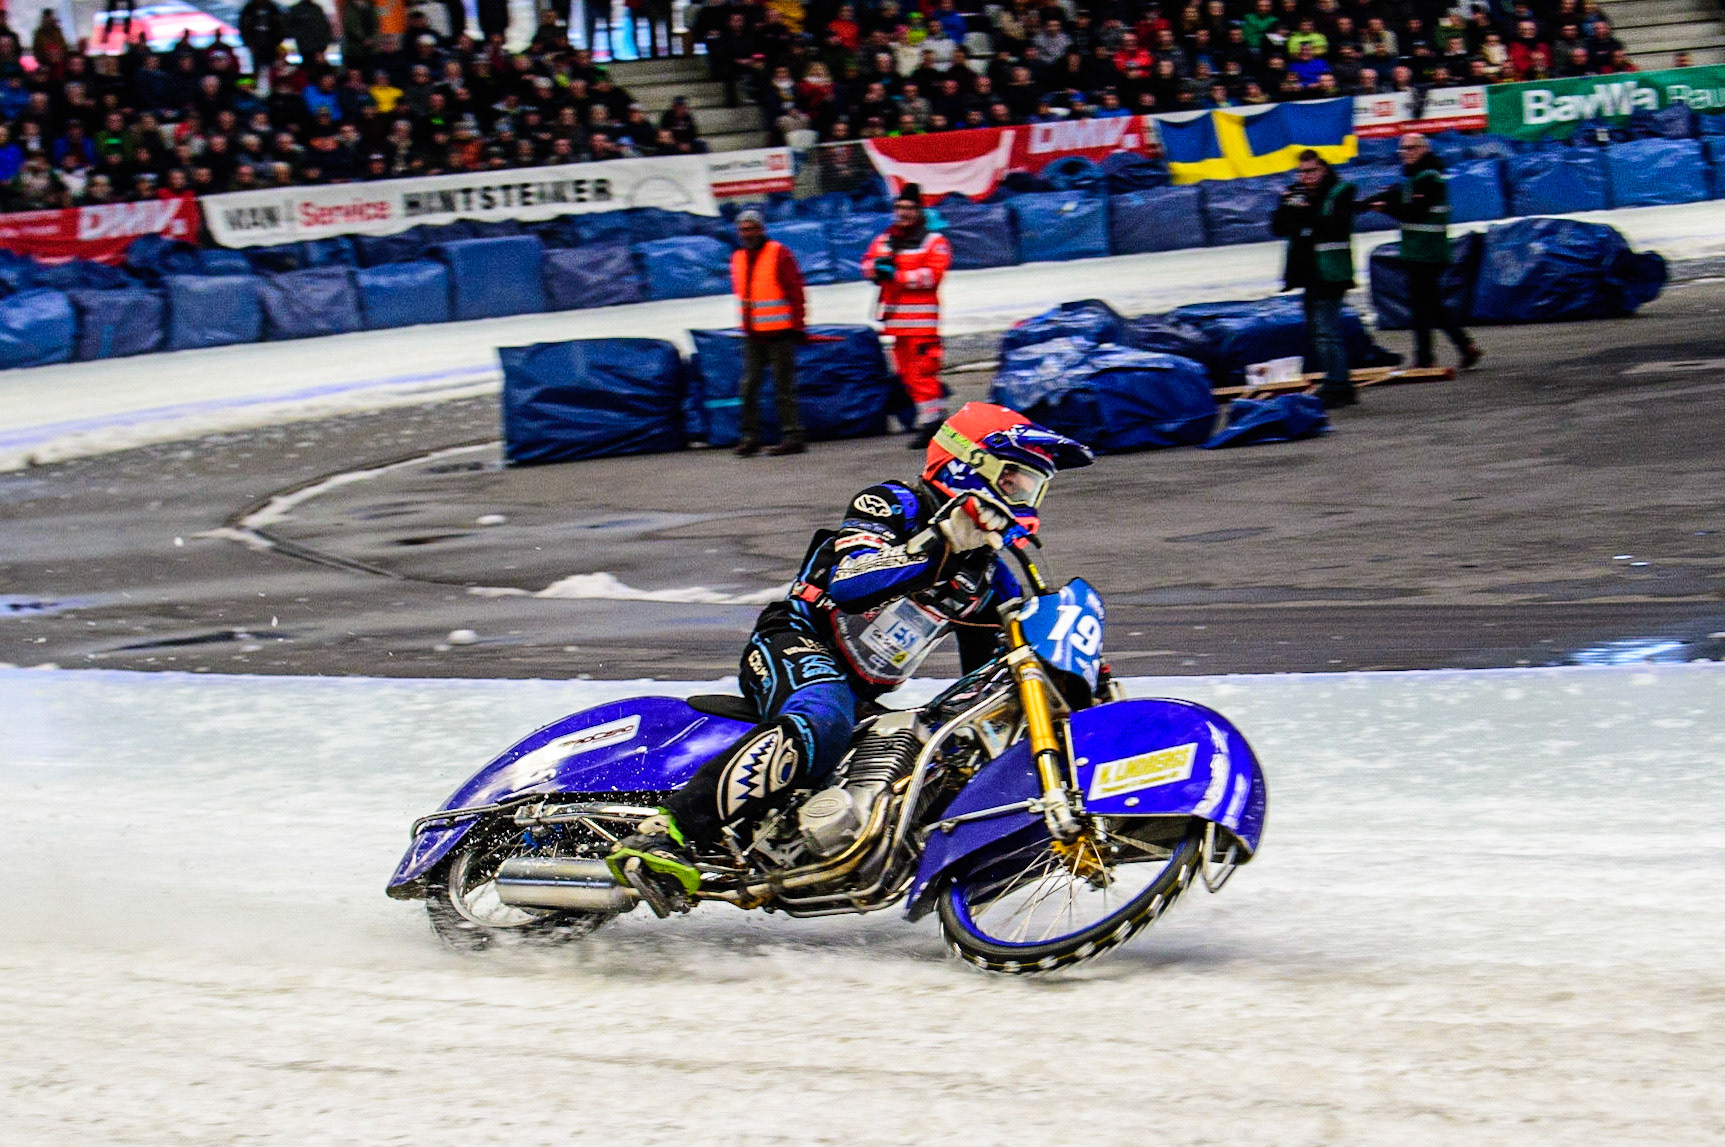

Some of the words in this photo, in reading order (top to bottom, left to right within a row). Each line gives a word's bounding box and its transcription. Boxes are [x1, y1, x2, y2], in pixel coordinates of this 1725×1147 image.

[1522, 81, 1658, 125] BayWa
[300, 199, 391, 228] Service
[403, 178, 612, 217] HINTSTEINER
[1047, 604, 1102, 656] 19
